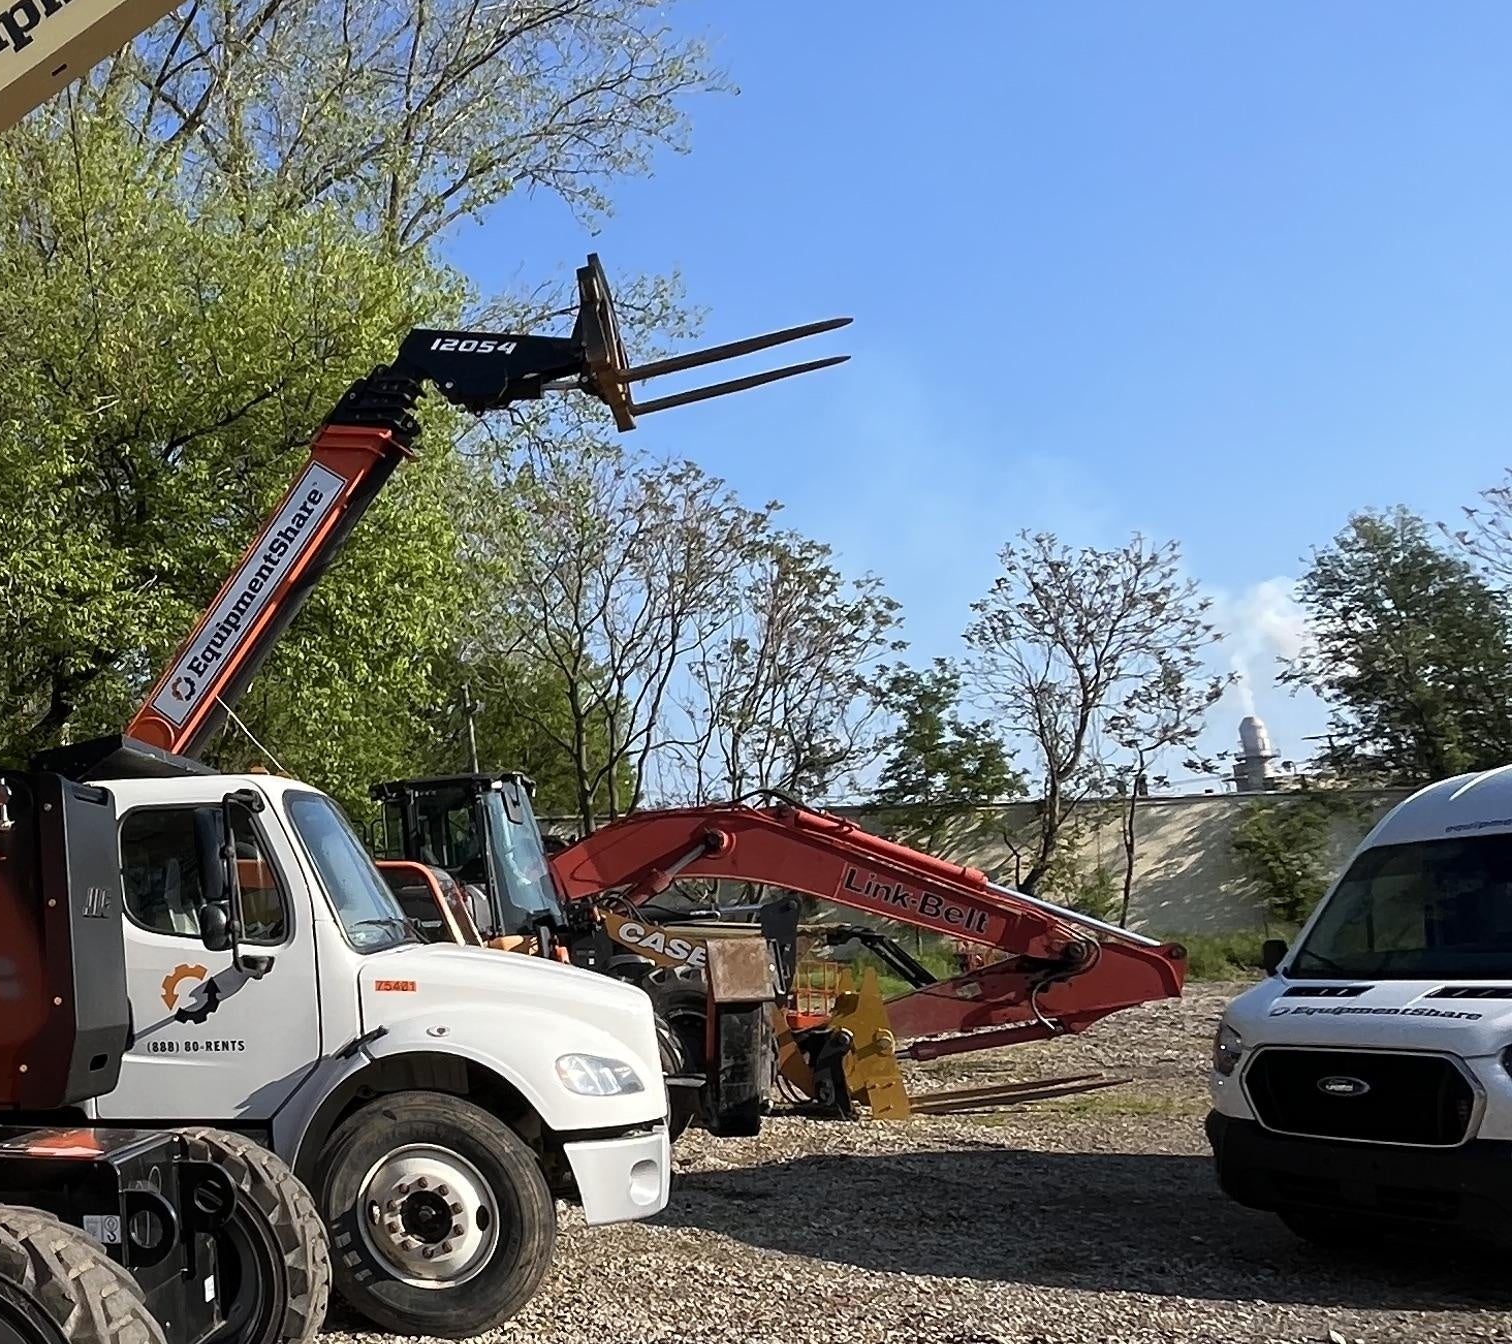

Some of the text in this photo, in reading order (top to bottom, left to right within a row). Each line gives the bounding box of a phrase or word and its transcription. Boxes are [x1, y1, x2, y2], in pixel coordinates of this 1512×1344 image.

[430, 338, 518, 355] 12054
[187, 488, 324, 678] EquipmentShare
[844, 868, 989, 934] Link-Belt
[618, 922, 706, 968] CASE
[1290, 1006, 1482, 1021] EquipmentShare
[147, 1040, 245, 1053] (888) 80-RENTS
